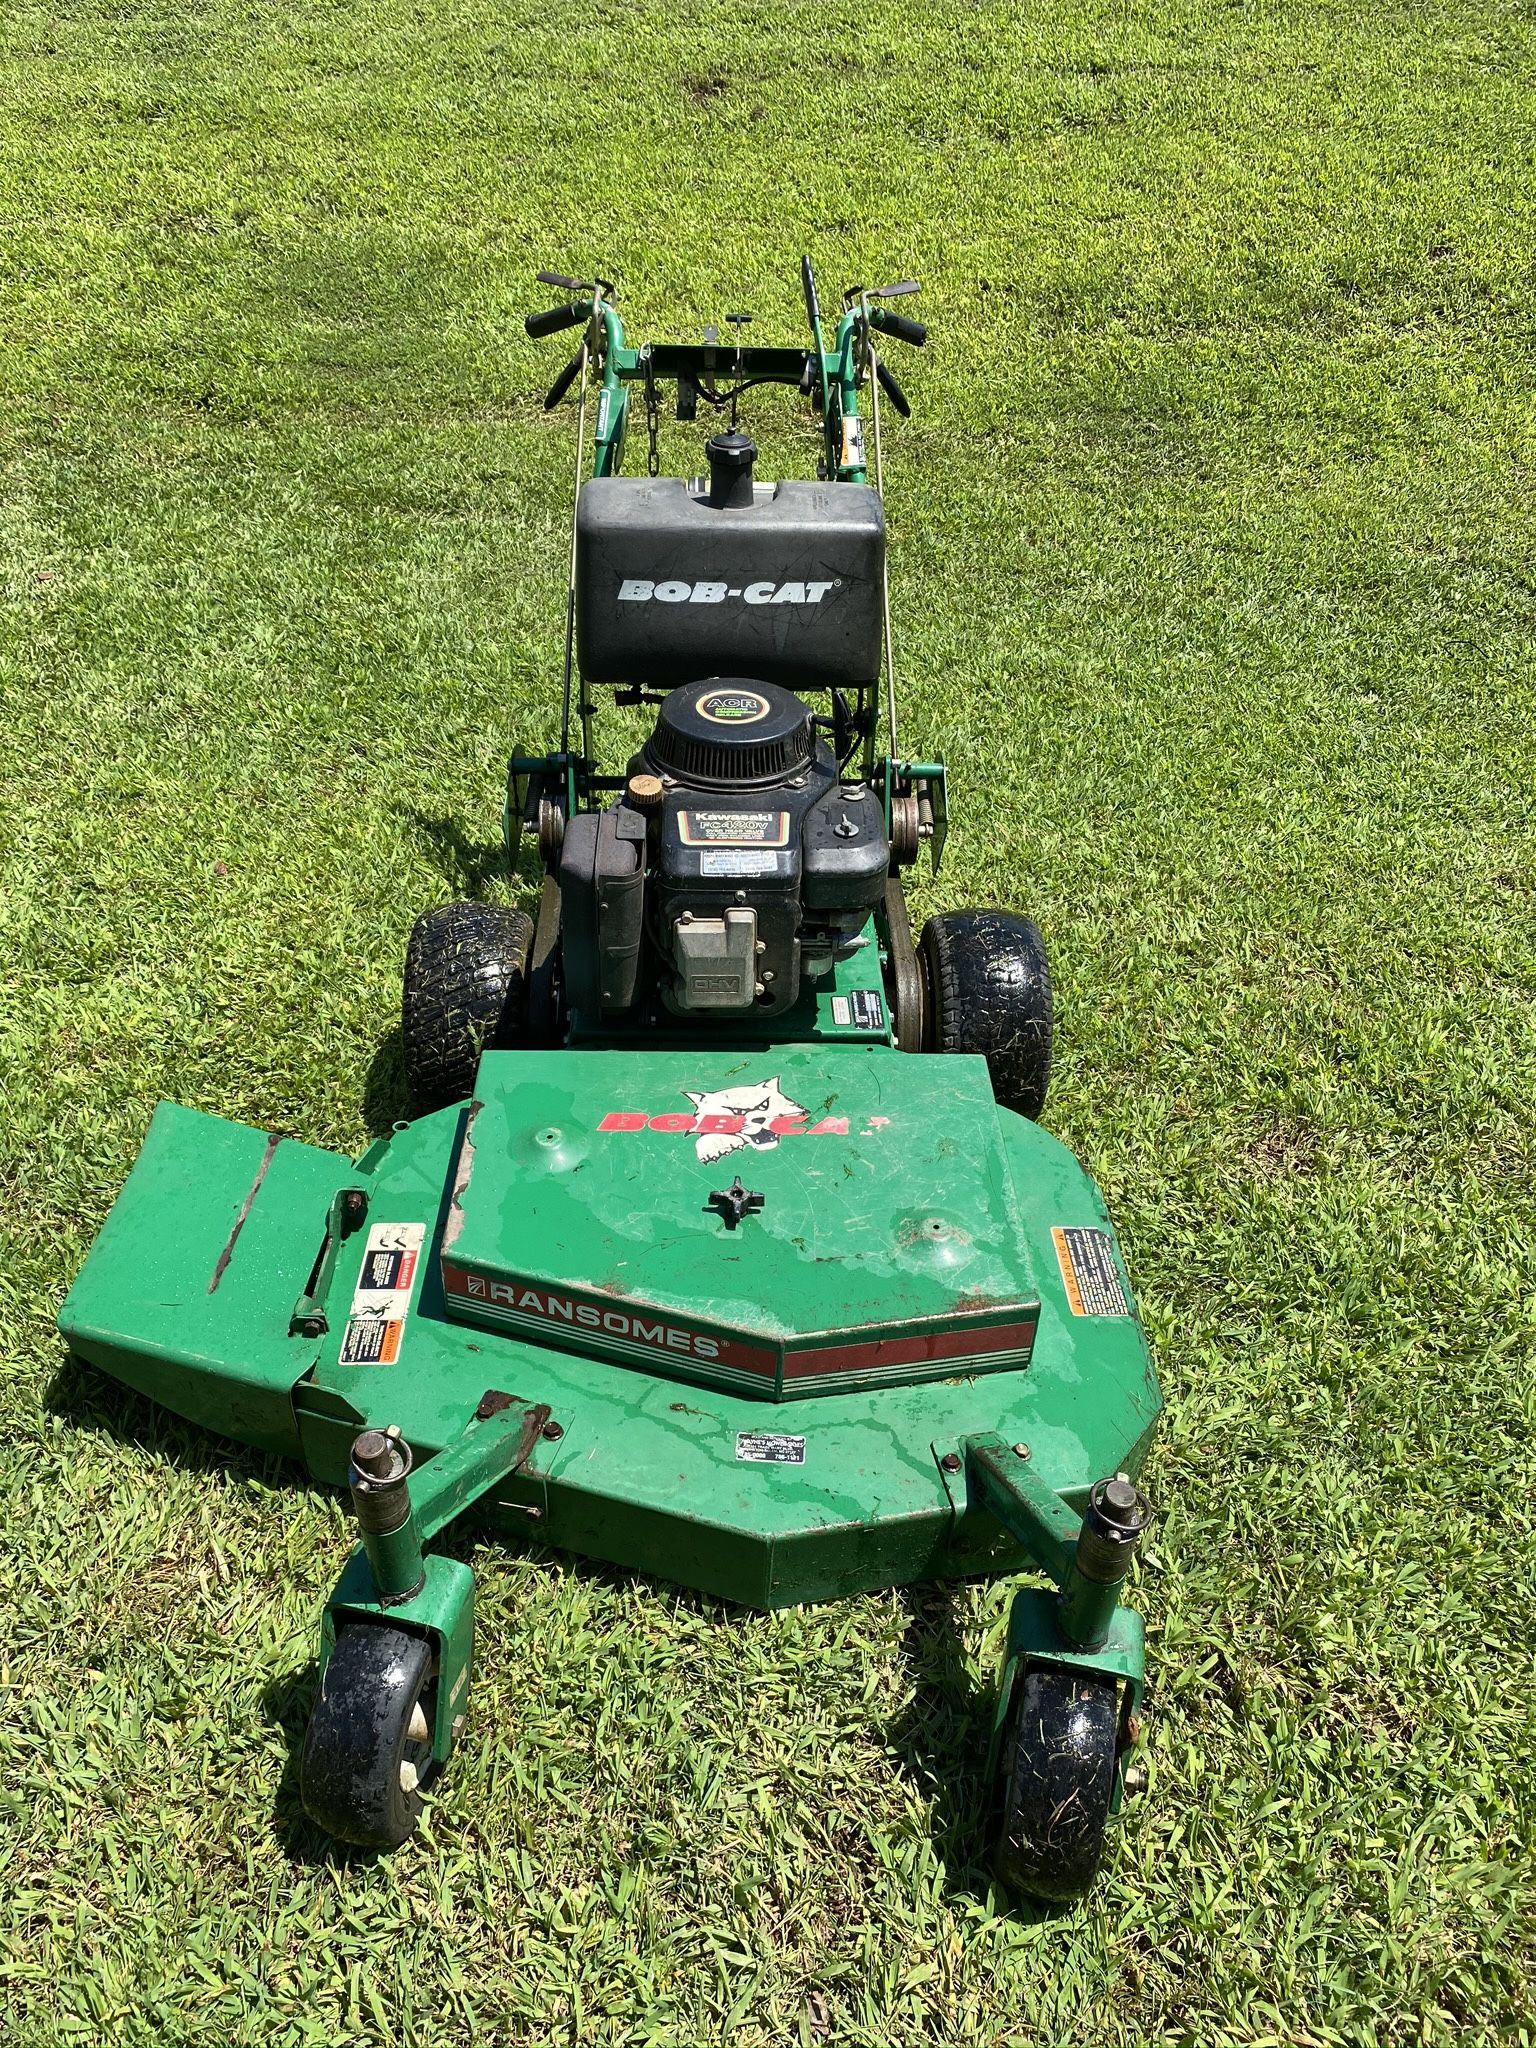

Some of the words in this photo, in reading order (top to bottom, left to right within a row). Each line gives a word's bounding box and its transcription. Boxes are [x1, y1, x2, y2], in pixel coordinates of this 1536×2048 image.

[706, 698, 757, 708] ACR
[695, 813, 773, 821] Kawasaki
[694, 979, 737, 989] OHV
[596, 1112, 747, 1133] BOB
[399, 1260, 411, 1287] DANGER
[1059, 1246, 1077, 1294] WARNING
[383, 1330, 397, 1361] WARNING
